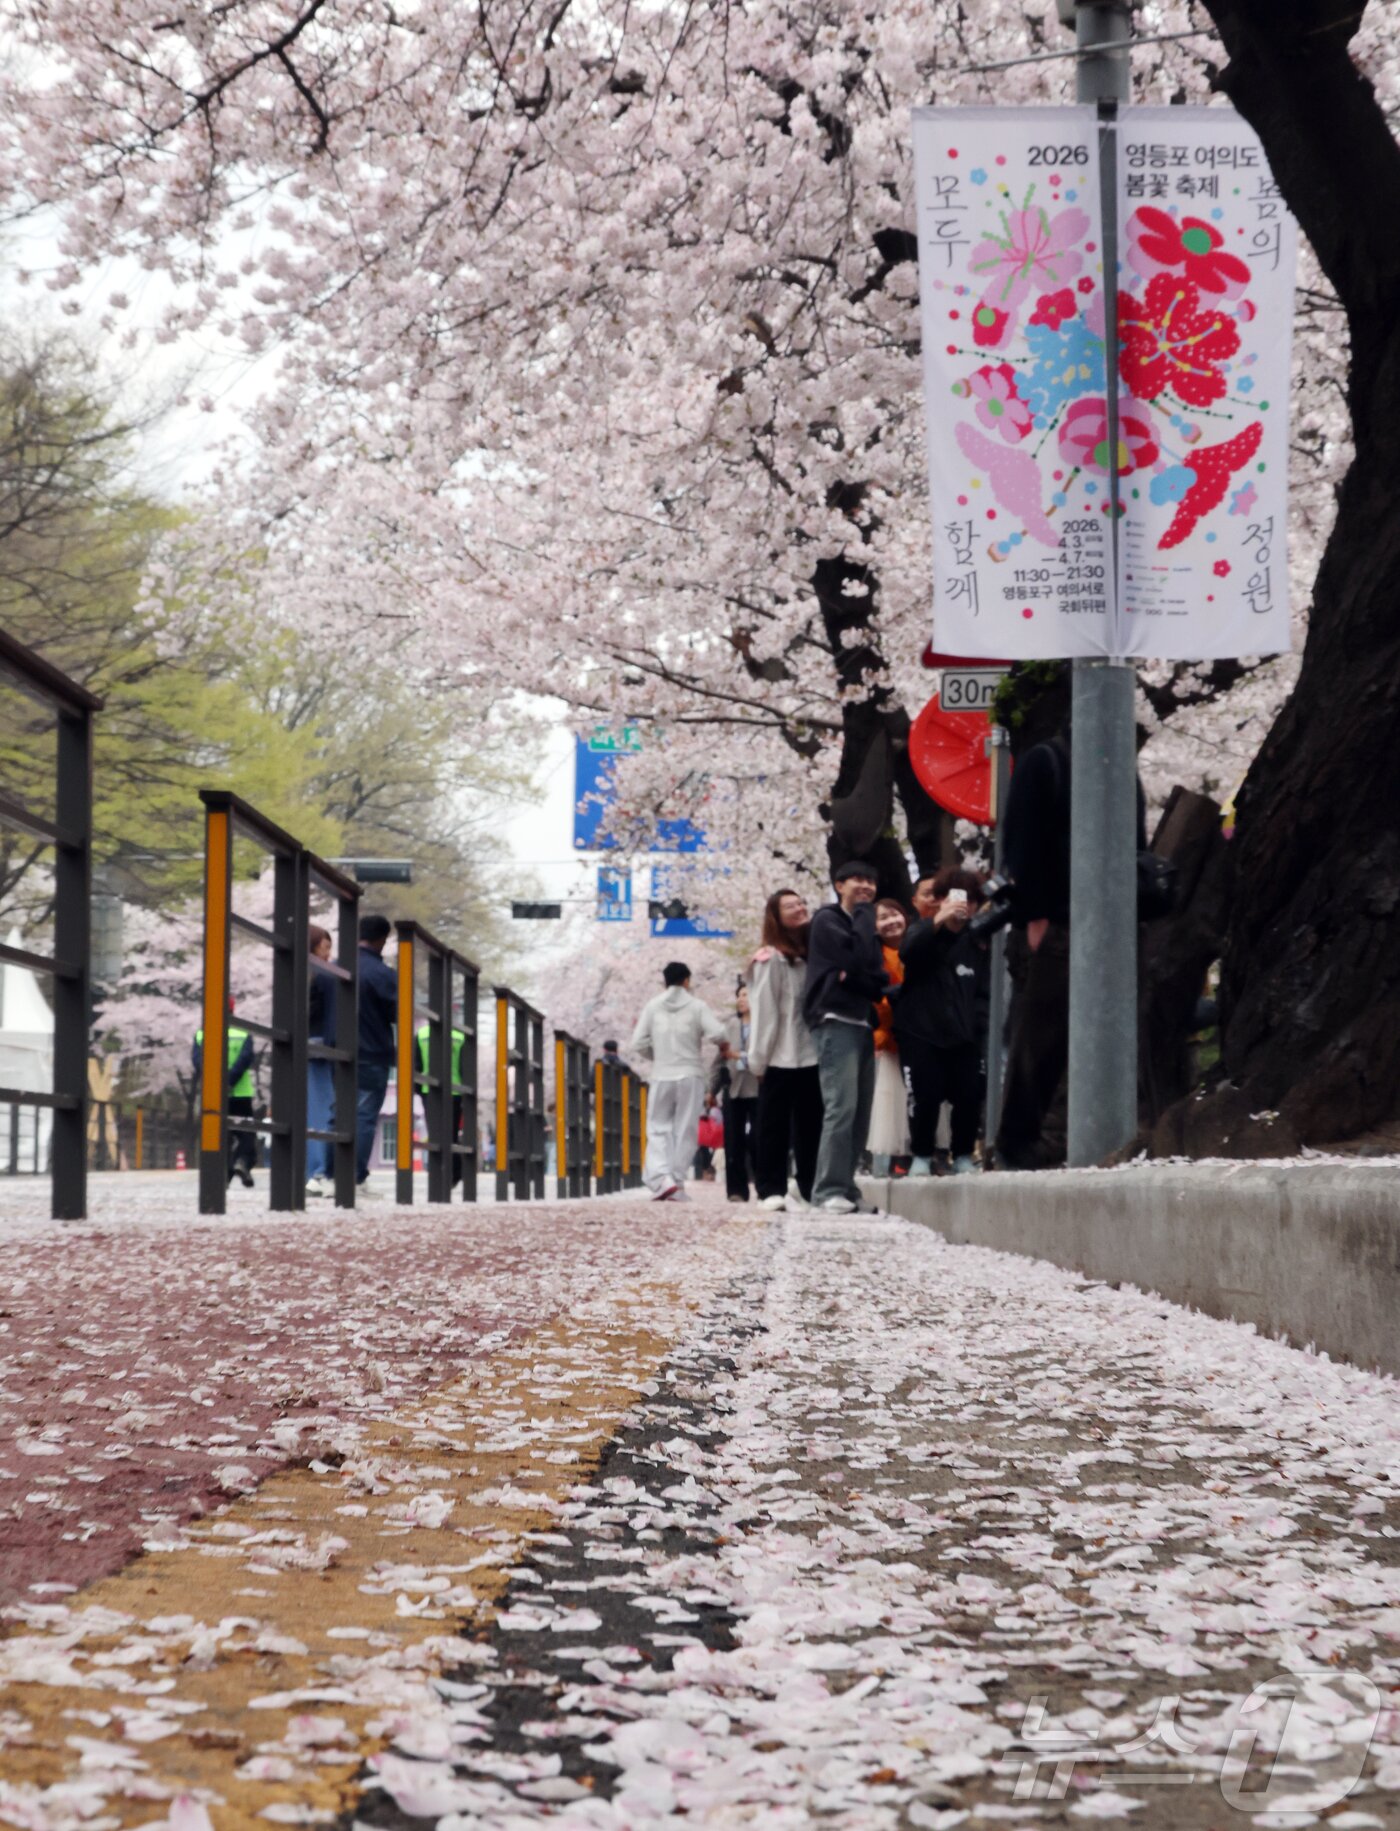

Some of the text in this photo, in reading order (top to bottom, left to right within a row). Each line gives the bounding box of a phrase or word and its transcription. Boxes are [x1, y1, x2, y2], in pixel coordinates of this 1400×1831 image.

[1027, 143, 1260, 170] 2026 영등포 여의도
[1125, 173, 1220, 198] 봄꽃 축제
[925, 175, 972, 269] 모두
[1247, 176, 1283, 272] 봄의
[1062, 519, 1103, 534] 2026.
[943, 519, 982, 618] 함께
[1002, 582, 1105, 600] 영등포구 여의서로
[1241, 515, 1275, 615] 정원
